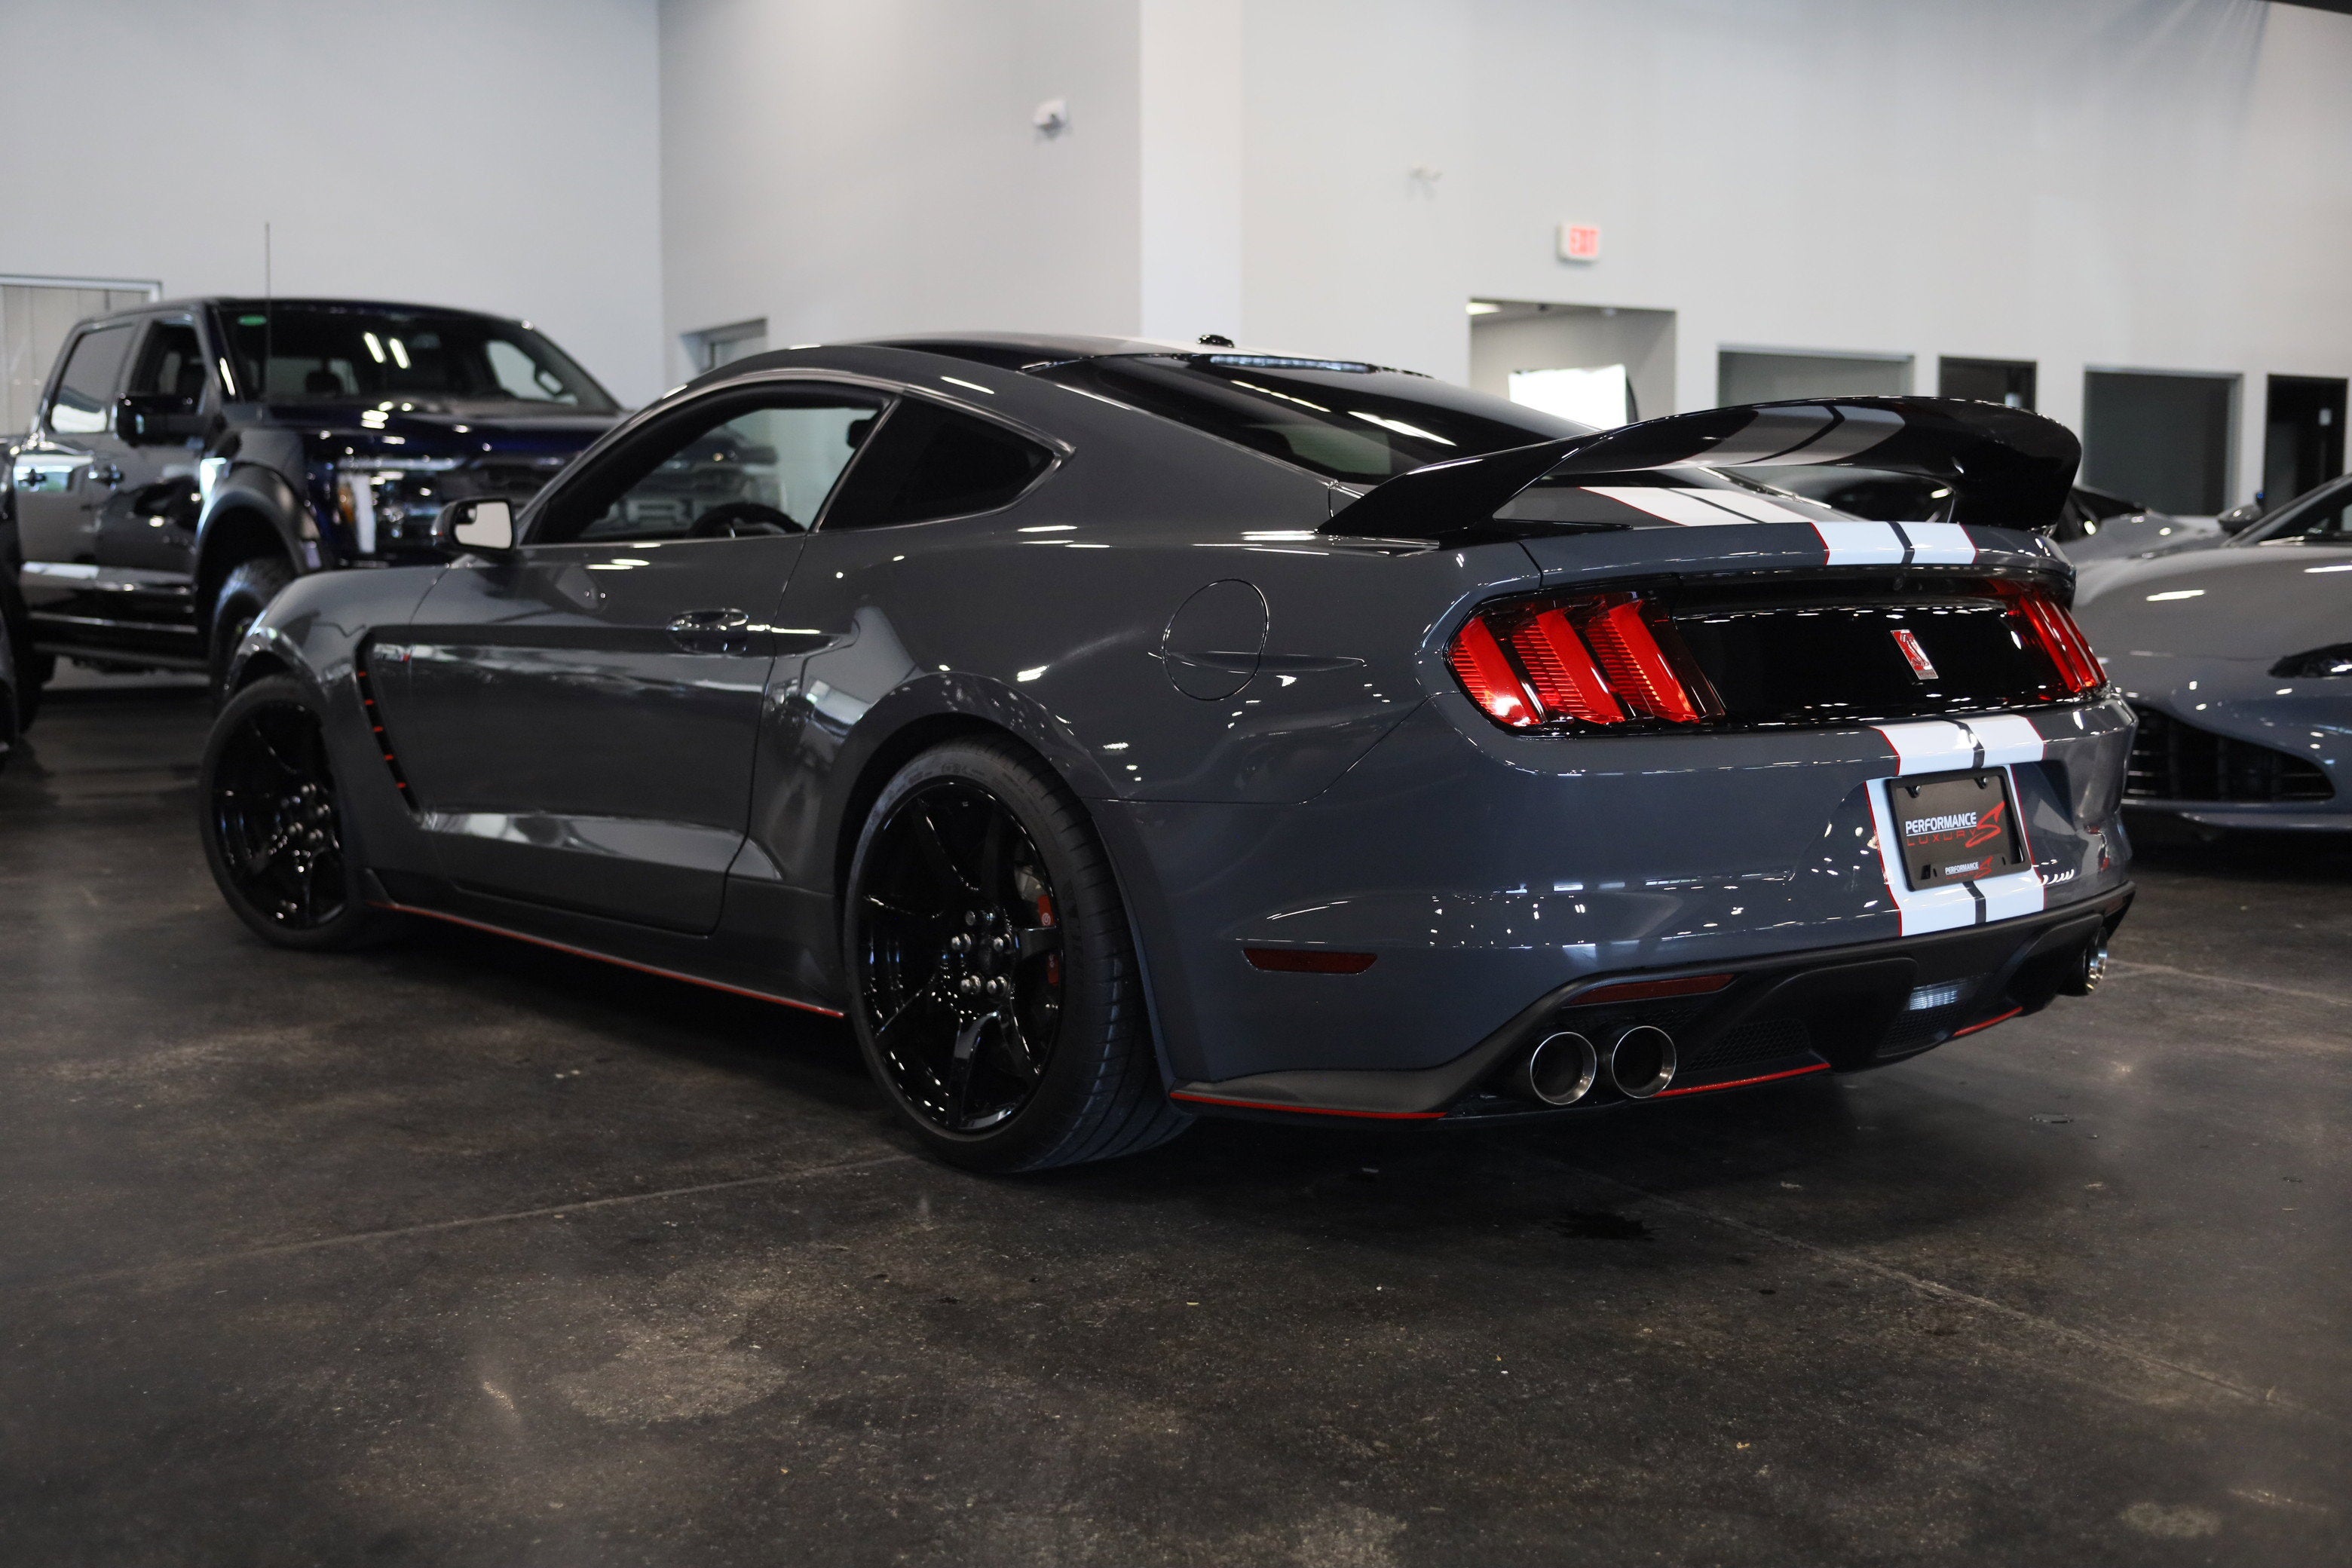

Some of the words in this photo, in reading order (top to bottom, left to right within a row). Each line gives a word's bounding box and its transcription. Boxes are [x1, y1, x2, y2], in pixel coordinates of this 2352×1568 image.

[1905, 811, 1977, 835] PERFORMANCE
[1906, 828, 1976, 847] LUXURY
[1945, 861, 1979, 874] PERFORMANCE
